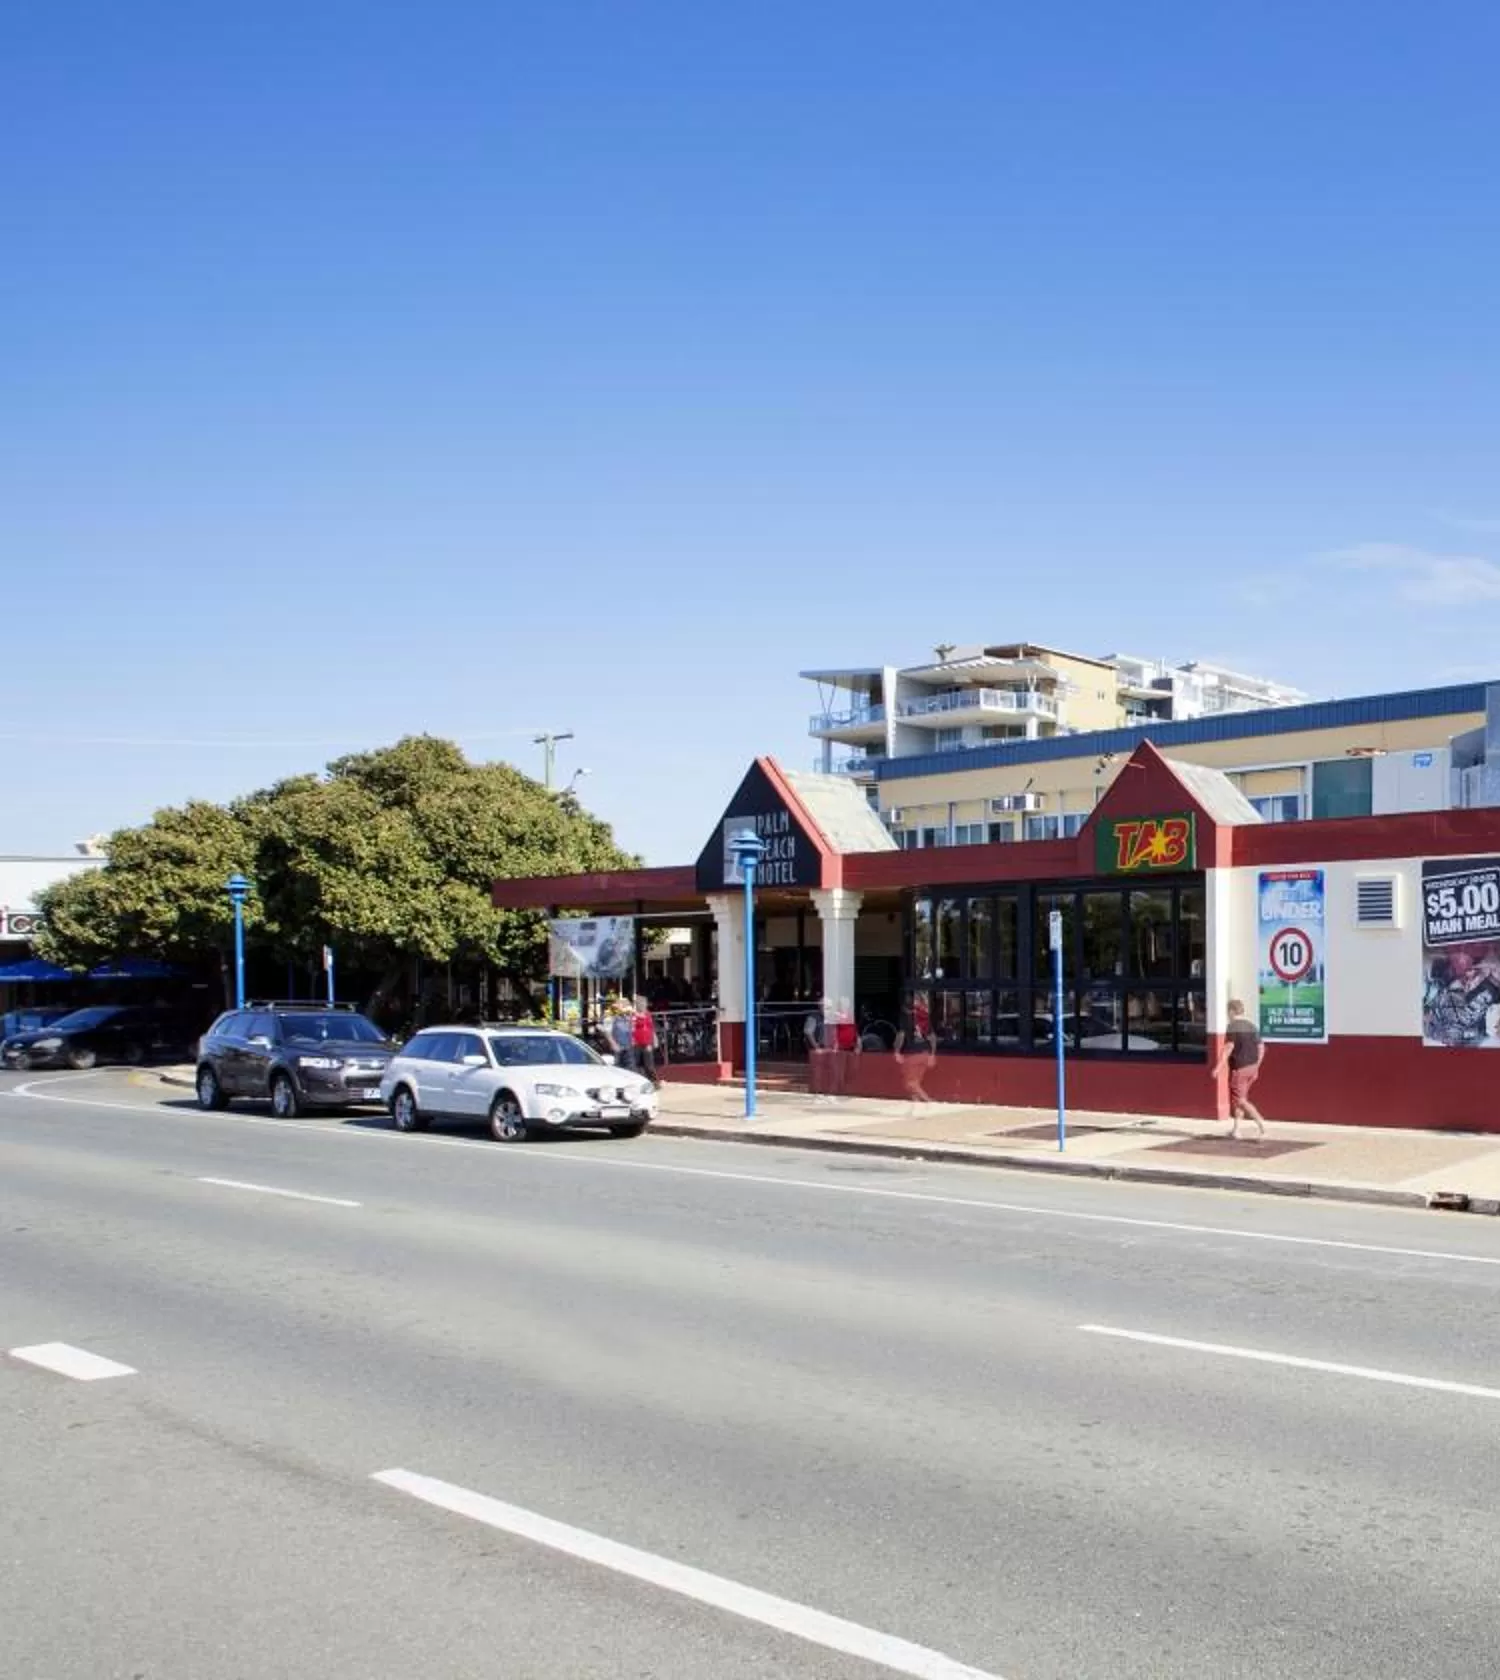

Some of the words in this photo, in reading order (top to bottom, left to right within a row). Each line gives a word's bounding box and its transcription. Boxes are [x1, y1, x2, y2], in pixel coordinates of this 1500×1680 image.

[757, 811, 789, 836] PALM
[1113, 818, 1189, 869] TAB
[757, 861, 797, 885] HOTEL
[1261, 901, 1322, 921] UNDER
[1427, 882, 1500, 918] $5.00
[1429, 917, 1463, 935] MAIN
[1279, 941, 1303, 967] 10
